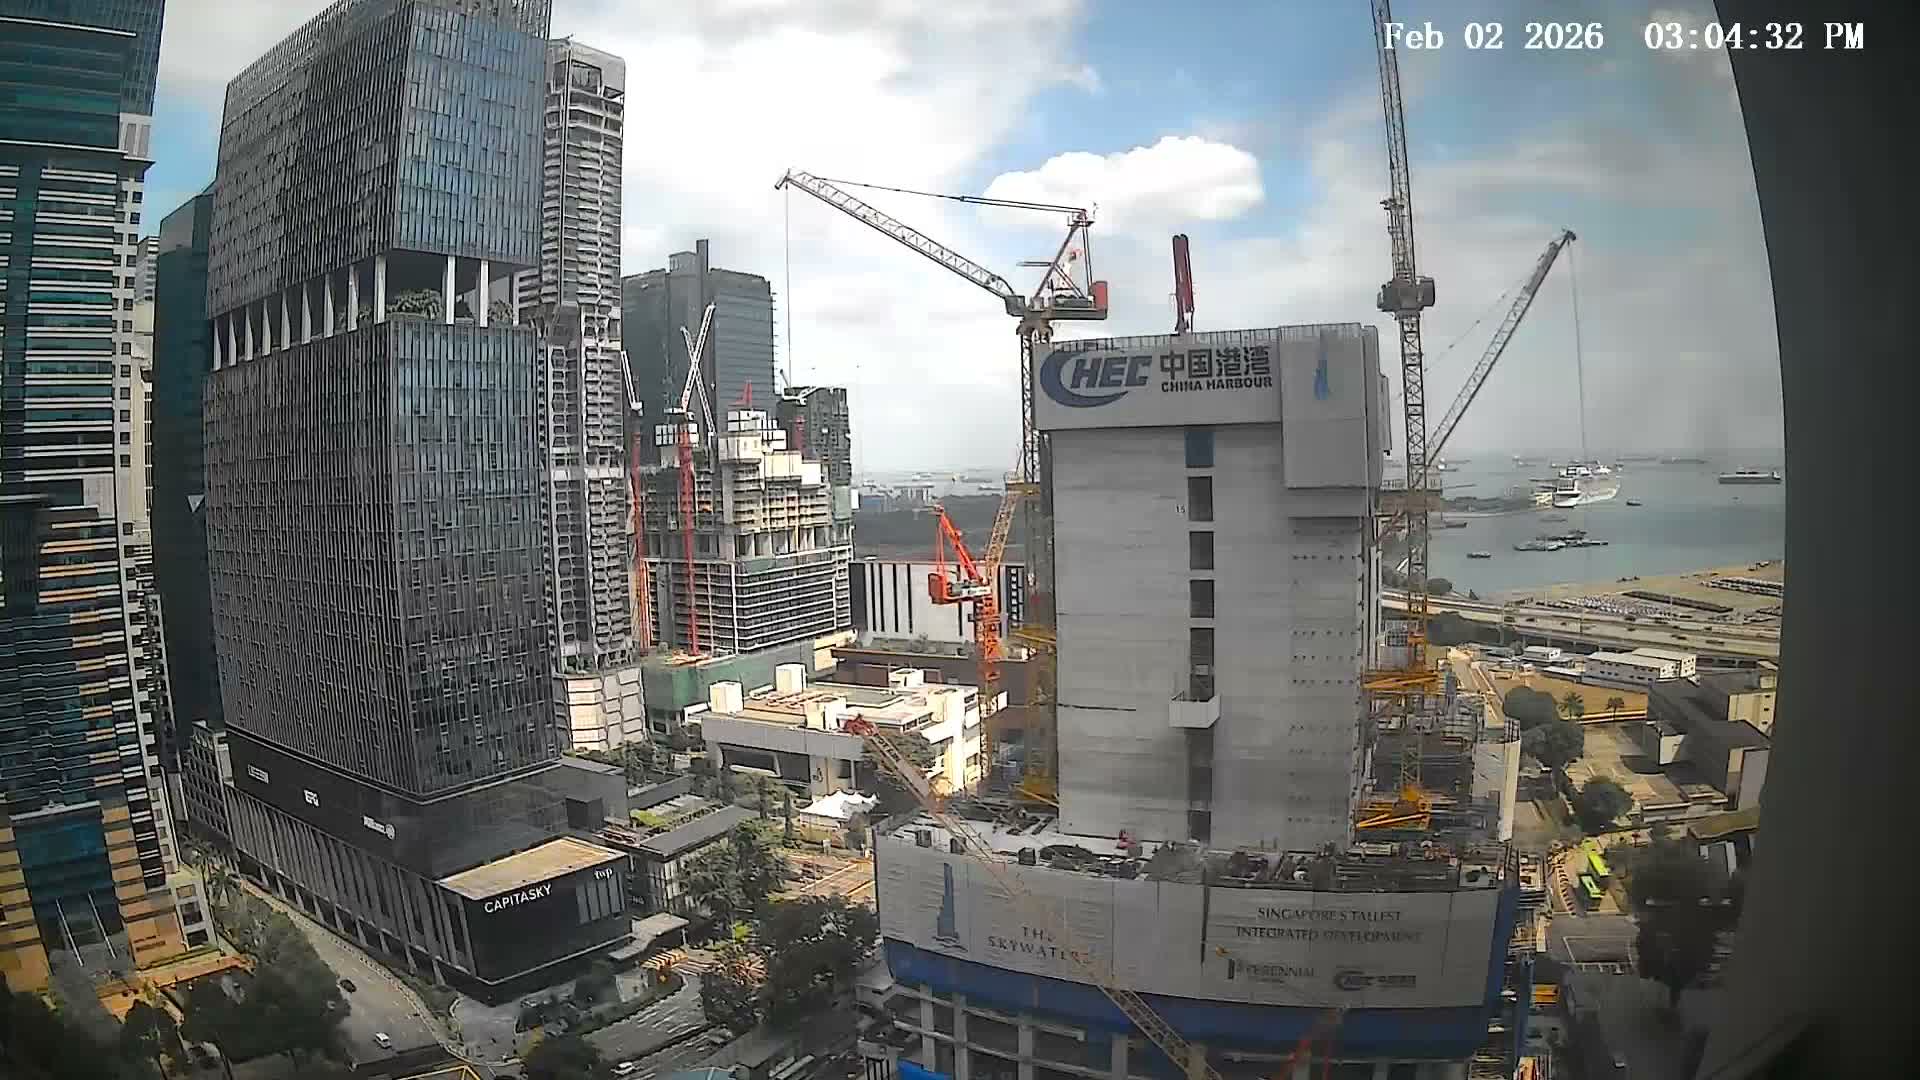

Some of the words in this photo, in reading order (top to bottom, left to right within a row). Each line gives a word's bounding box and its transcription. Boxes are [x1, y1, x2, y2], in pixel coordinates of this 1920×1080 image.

[1160, 346, 1272, 380] 中国港湾
[1040, 347, 1153, 408] CHEC
[1161, 380, 1202, 393] CHINA
[1206, 376, 1273, 391] HARBOUR
[484, 884, 552, 913] CAPITASKY
[1257, 907, 1347, 922] SINGAPORES
[1234, 926, 1320, 943] INTEGRATED
